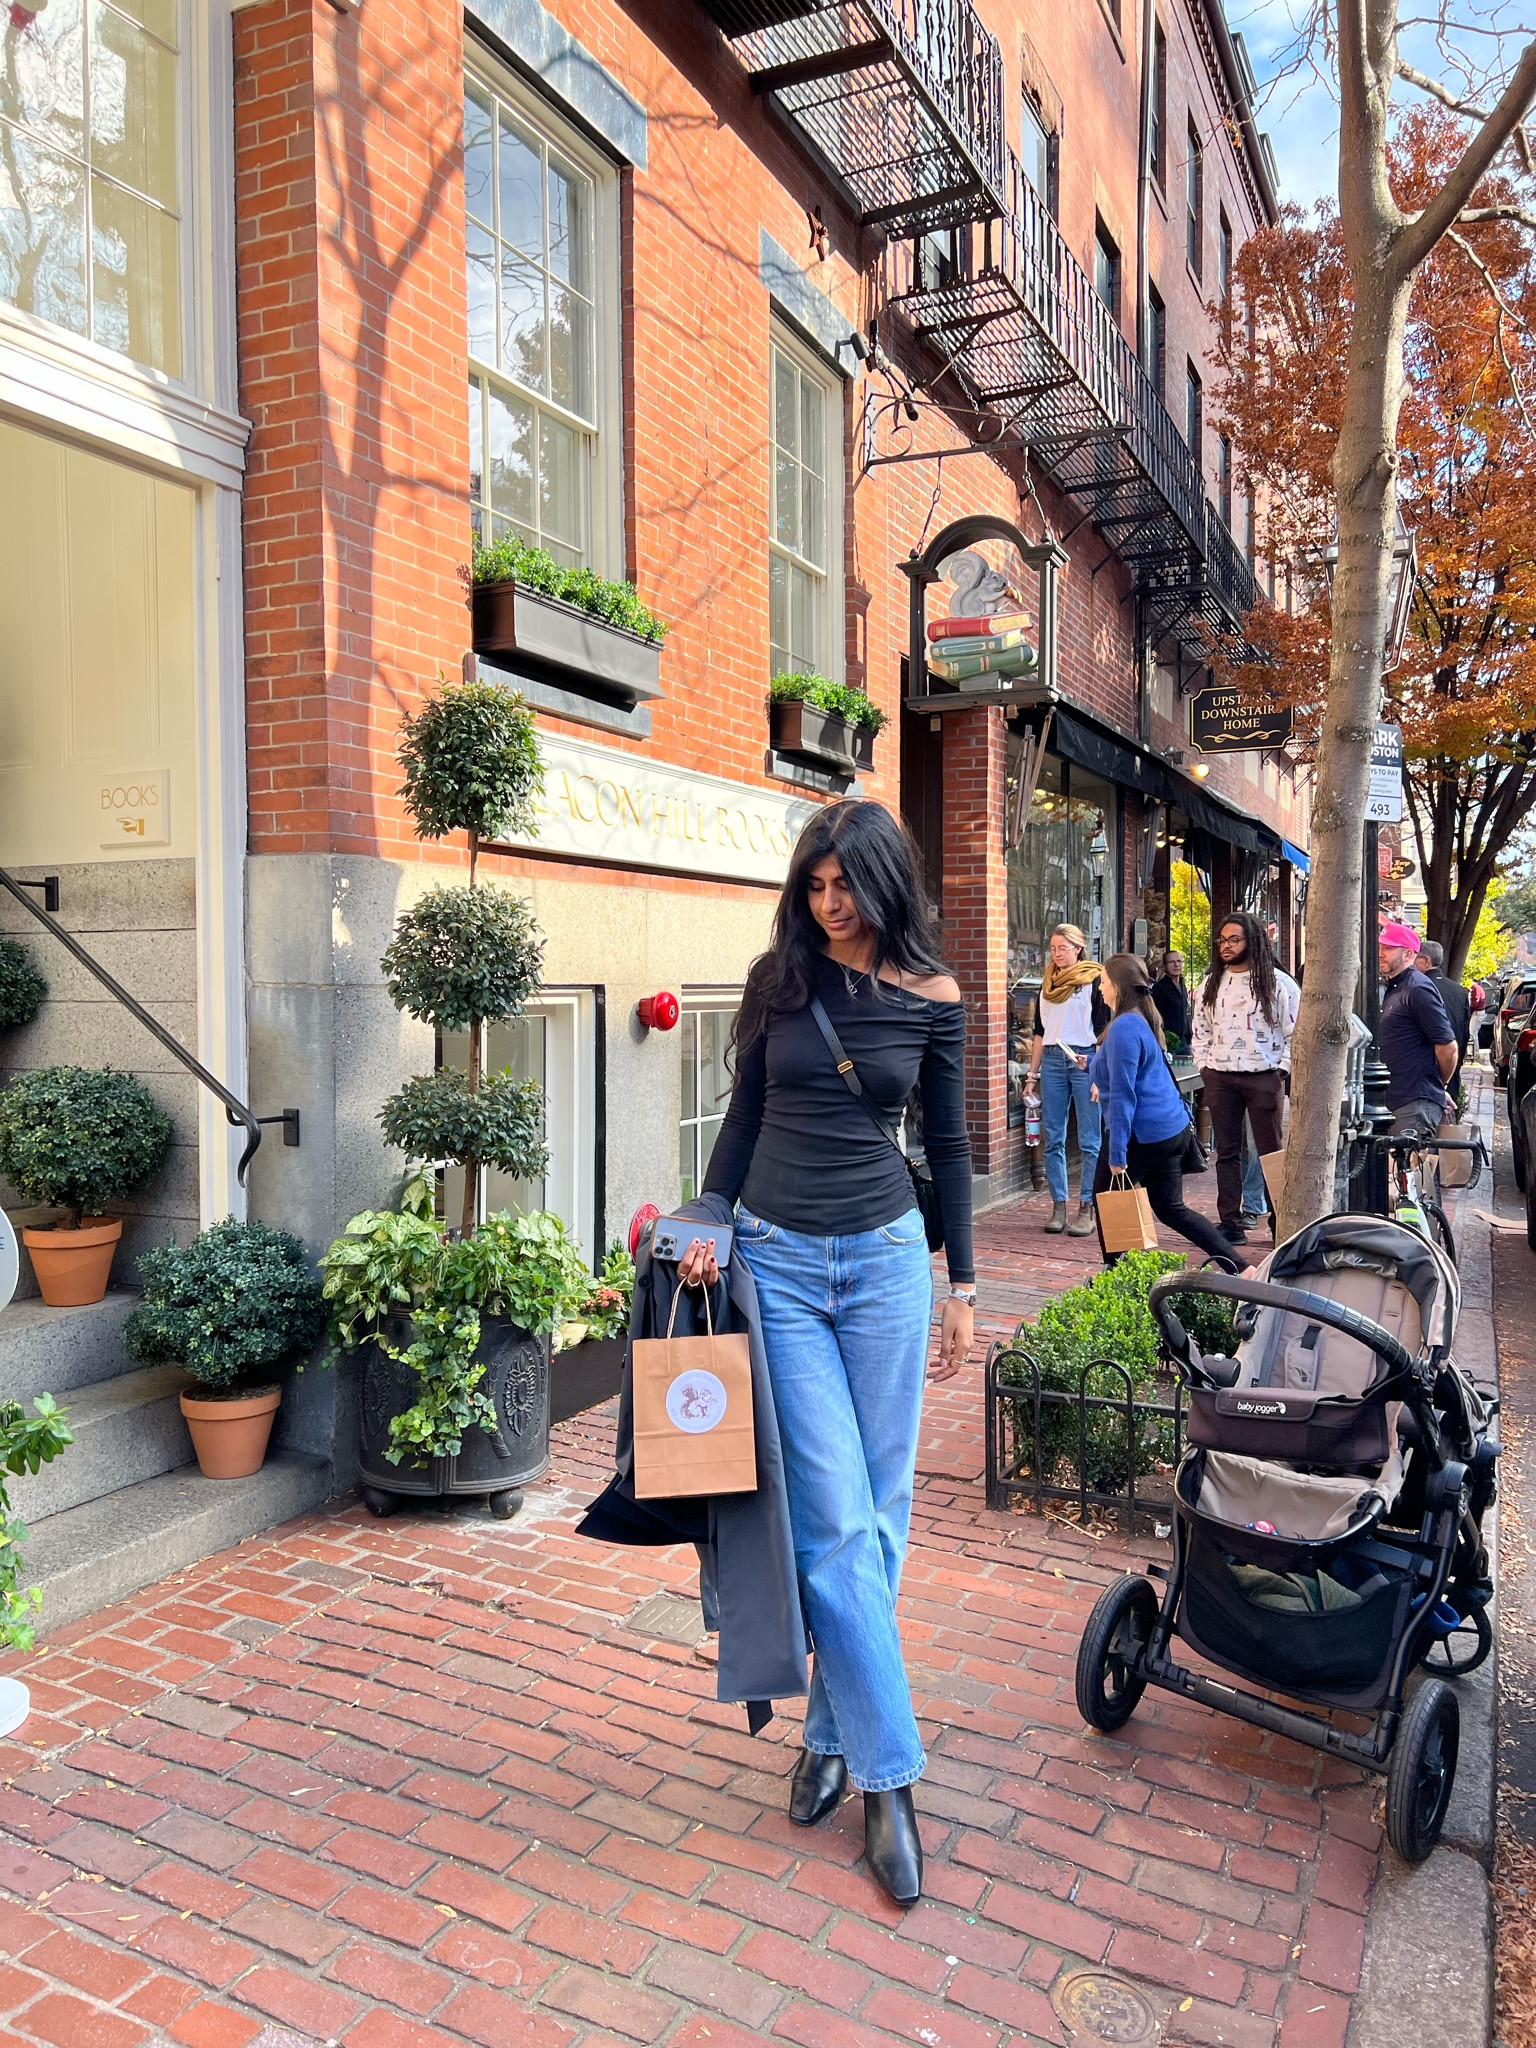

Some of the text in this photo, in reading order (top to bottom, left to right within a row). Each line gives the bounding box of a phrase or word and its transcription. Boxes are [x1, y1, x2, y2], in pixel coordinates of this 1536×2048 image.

[1201, 704, 1282, 720] DOWNSTAIR
[1223, 718, 1261, 731] HOME
[1378, 768, 1387, 776] TO
[1387, 769, 1399, 778] PAY
[101, 783, 159, 810] BOOKS
[533, 770, 792, 858] ACON HILL BOOKS
[1370, 803, 1391, 816] 493
[1237, 1401, 1279, 1415] baby jogger
